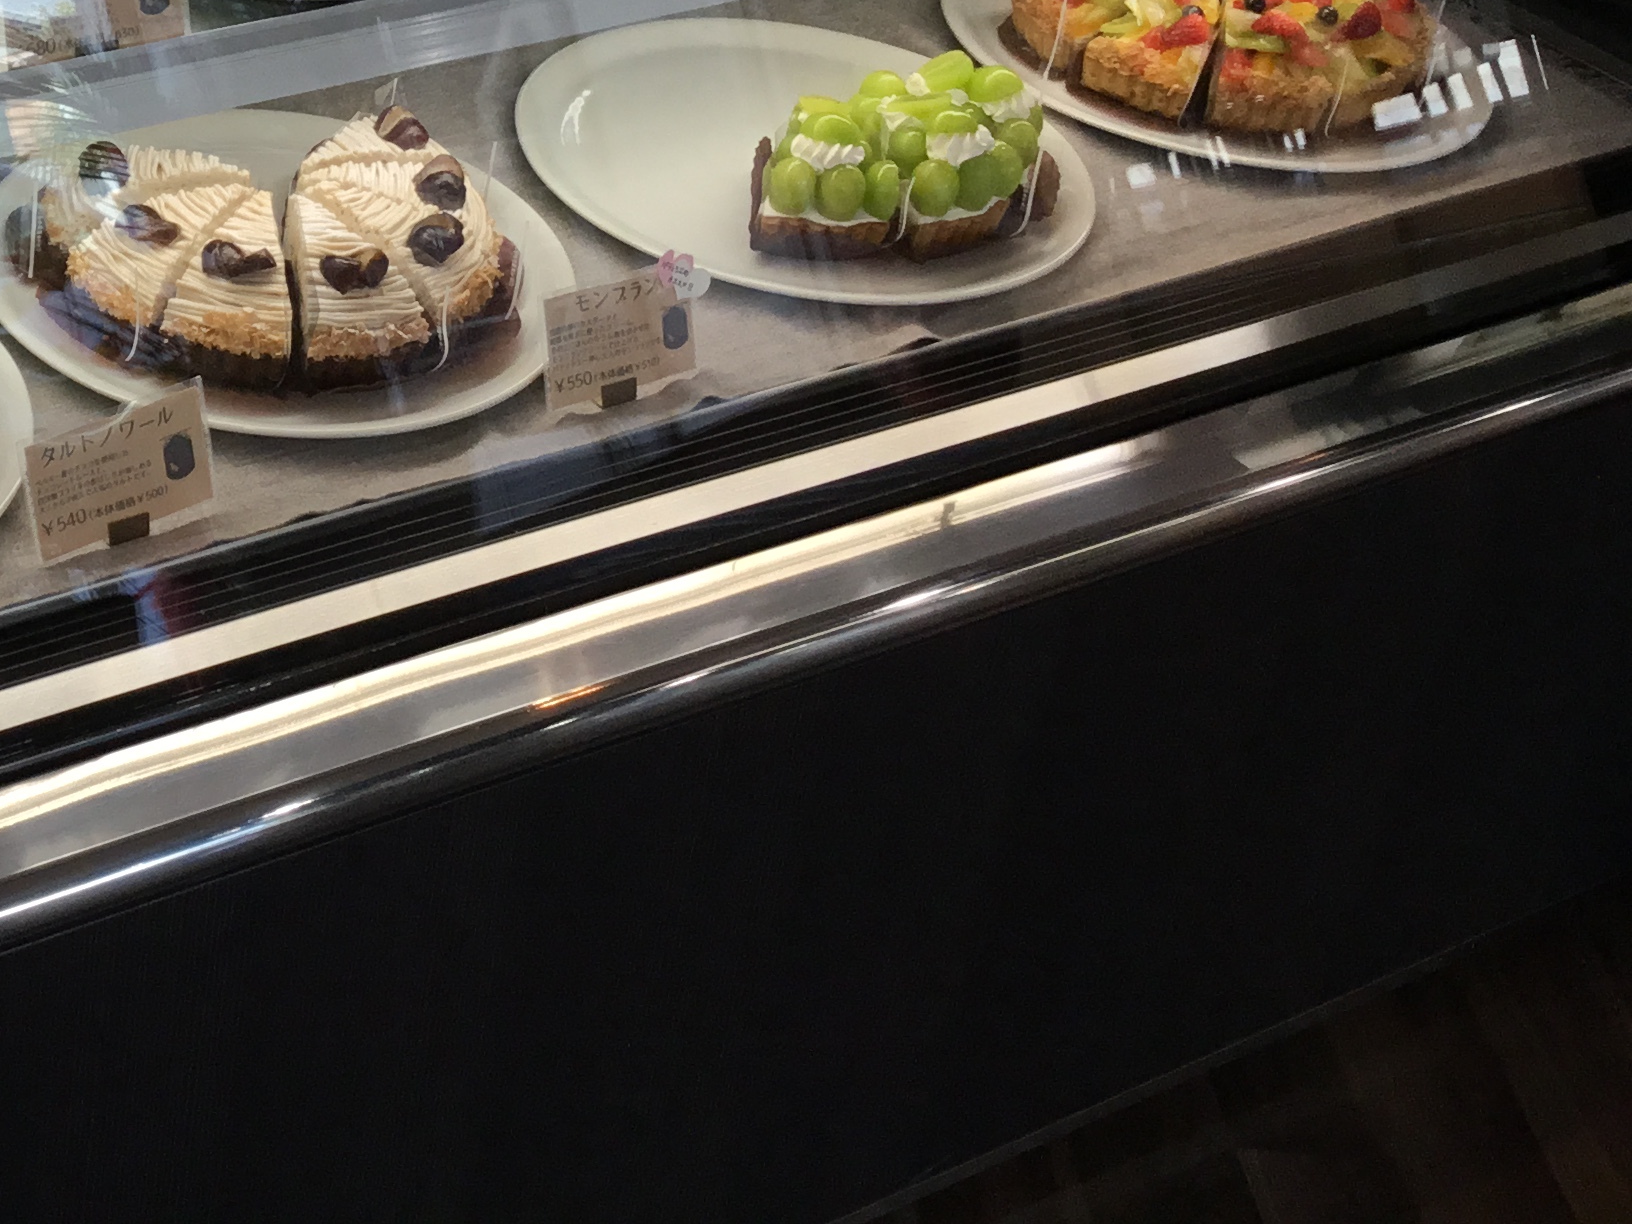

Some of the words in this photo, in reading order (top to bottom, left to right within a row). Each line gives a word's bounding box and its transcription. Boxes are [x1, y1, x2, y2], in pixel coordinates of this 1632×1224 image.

[575, 278, 658, 313] モンブラン
[554, 371, 593, 393] ¥550
[40, 406, 174, 469] タルトノワール
[40, 508, 87, 537] ¥540
